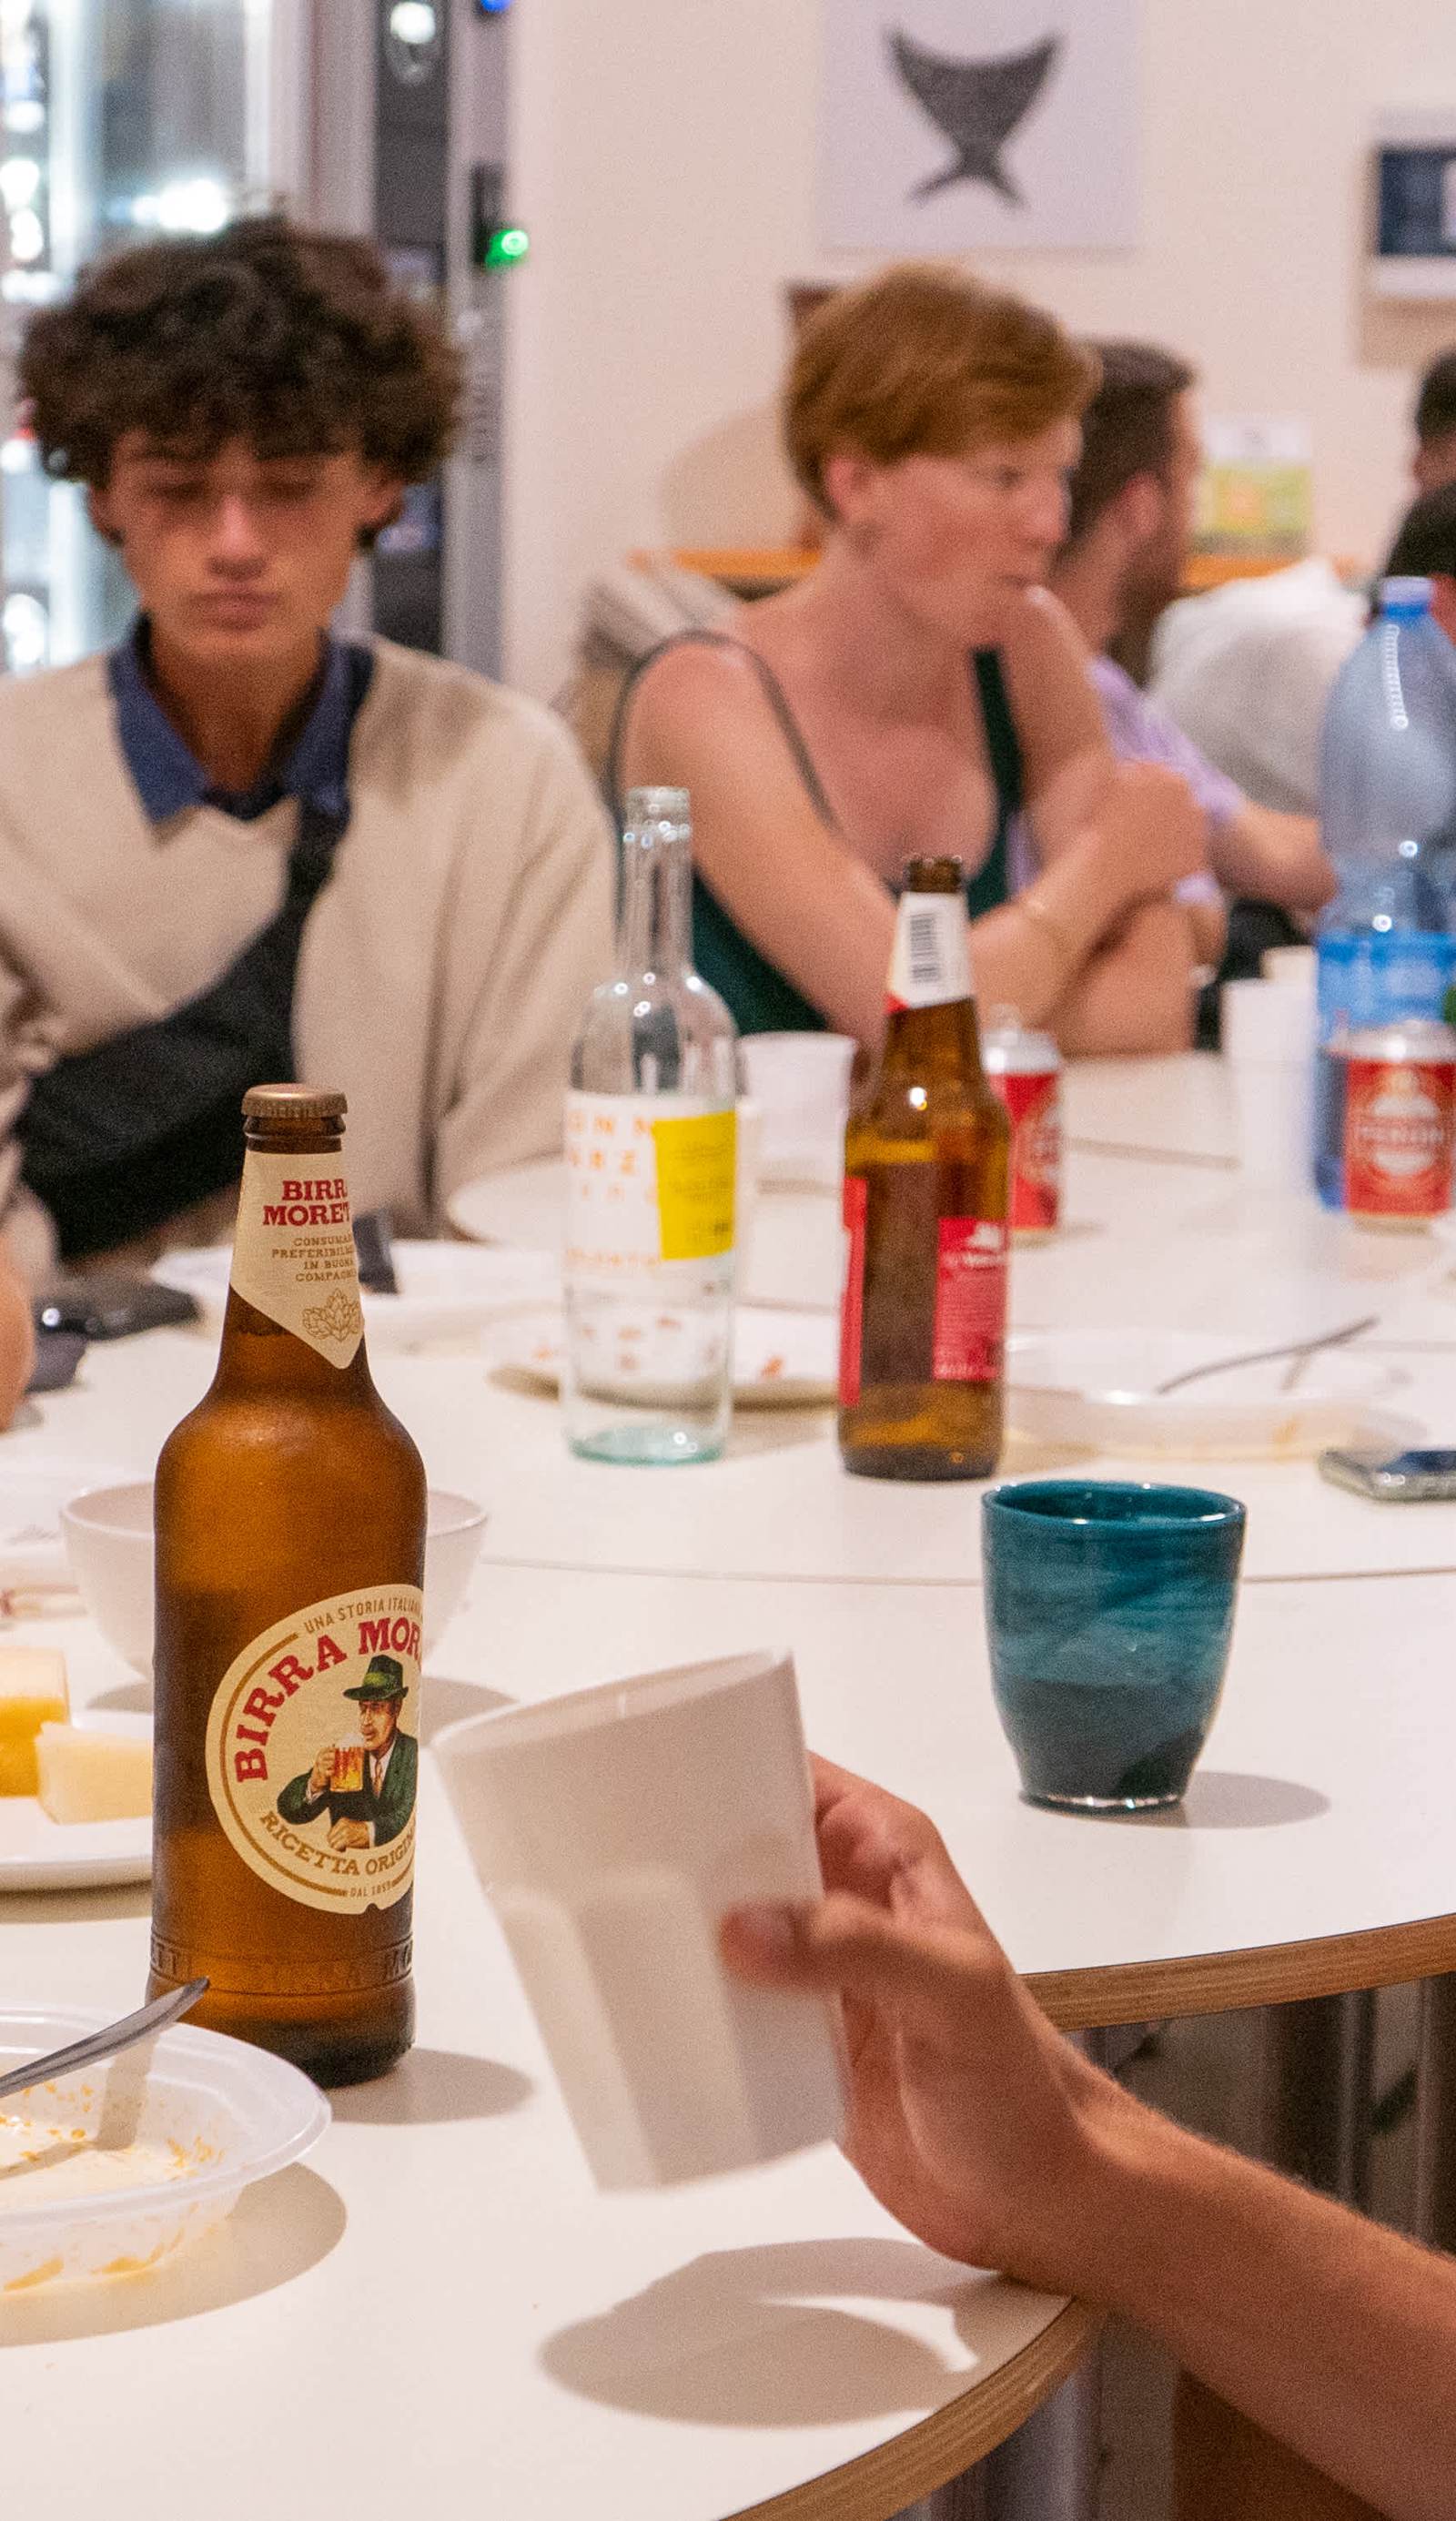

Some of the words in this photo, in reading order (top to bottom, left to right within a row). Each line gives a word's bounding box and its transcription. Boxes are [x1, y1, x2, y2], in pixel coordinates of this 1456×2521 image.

[281, 1179, 348, 1200] BIRR
[262, 1200, 349, 1226] MORET
[303, 1260, 318, 1271] IN
[304, 1612, 335, 1635] UNA
[338, 1599, 384, 1621] STORIA
[234, 1635, 348, 1782] BIRRA
[358, 1616, 421, 1662] MOR
[260, 1810, 360, 1876] RICETTA
[349, 1887, 368, 1898] DAL
